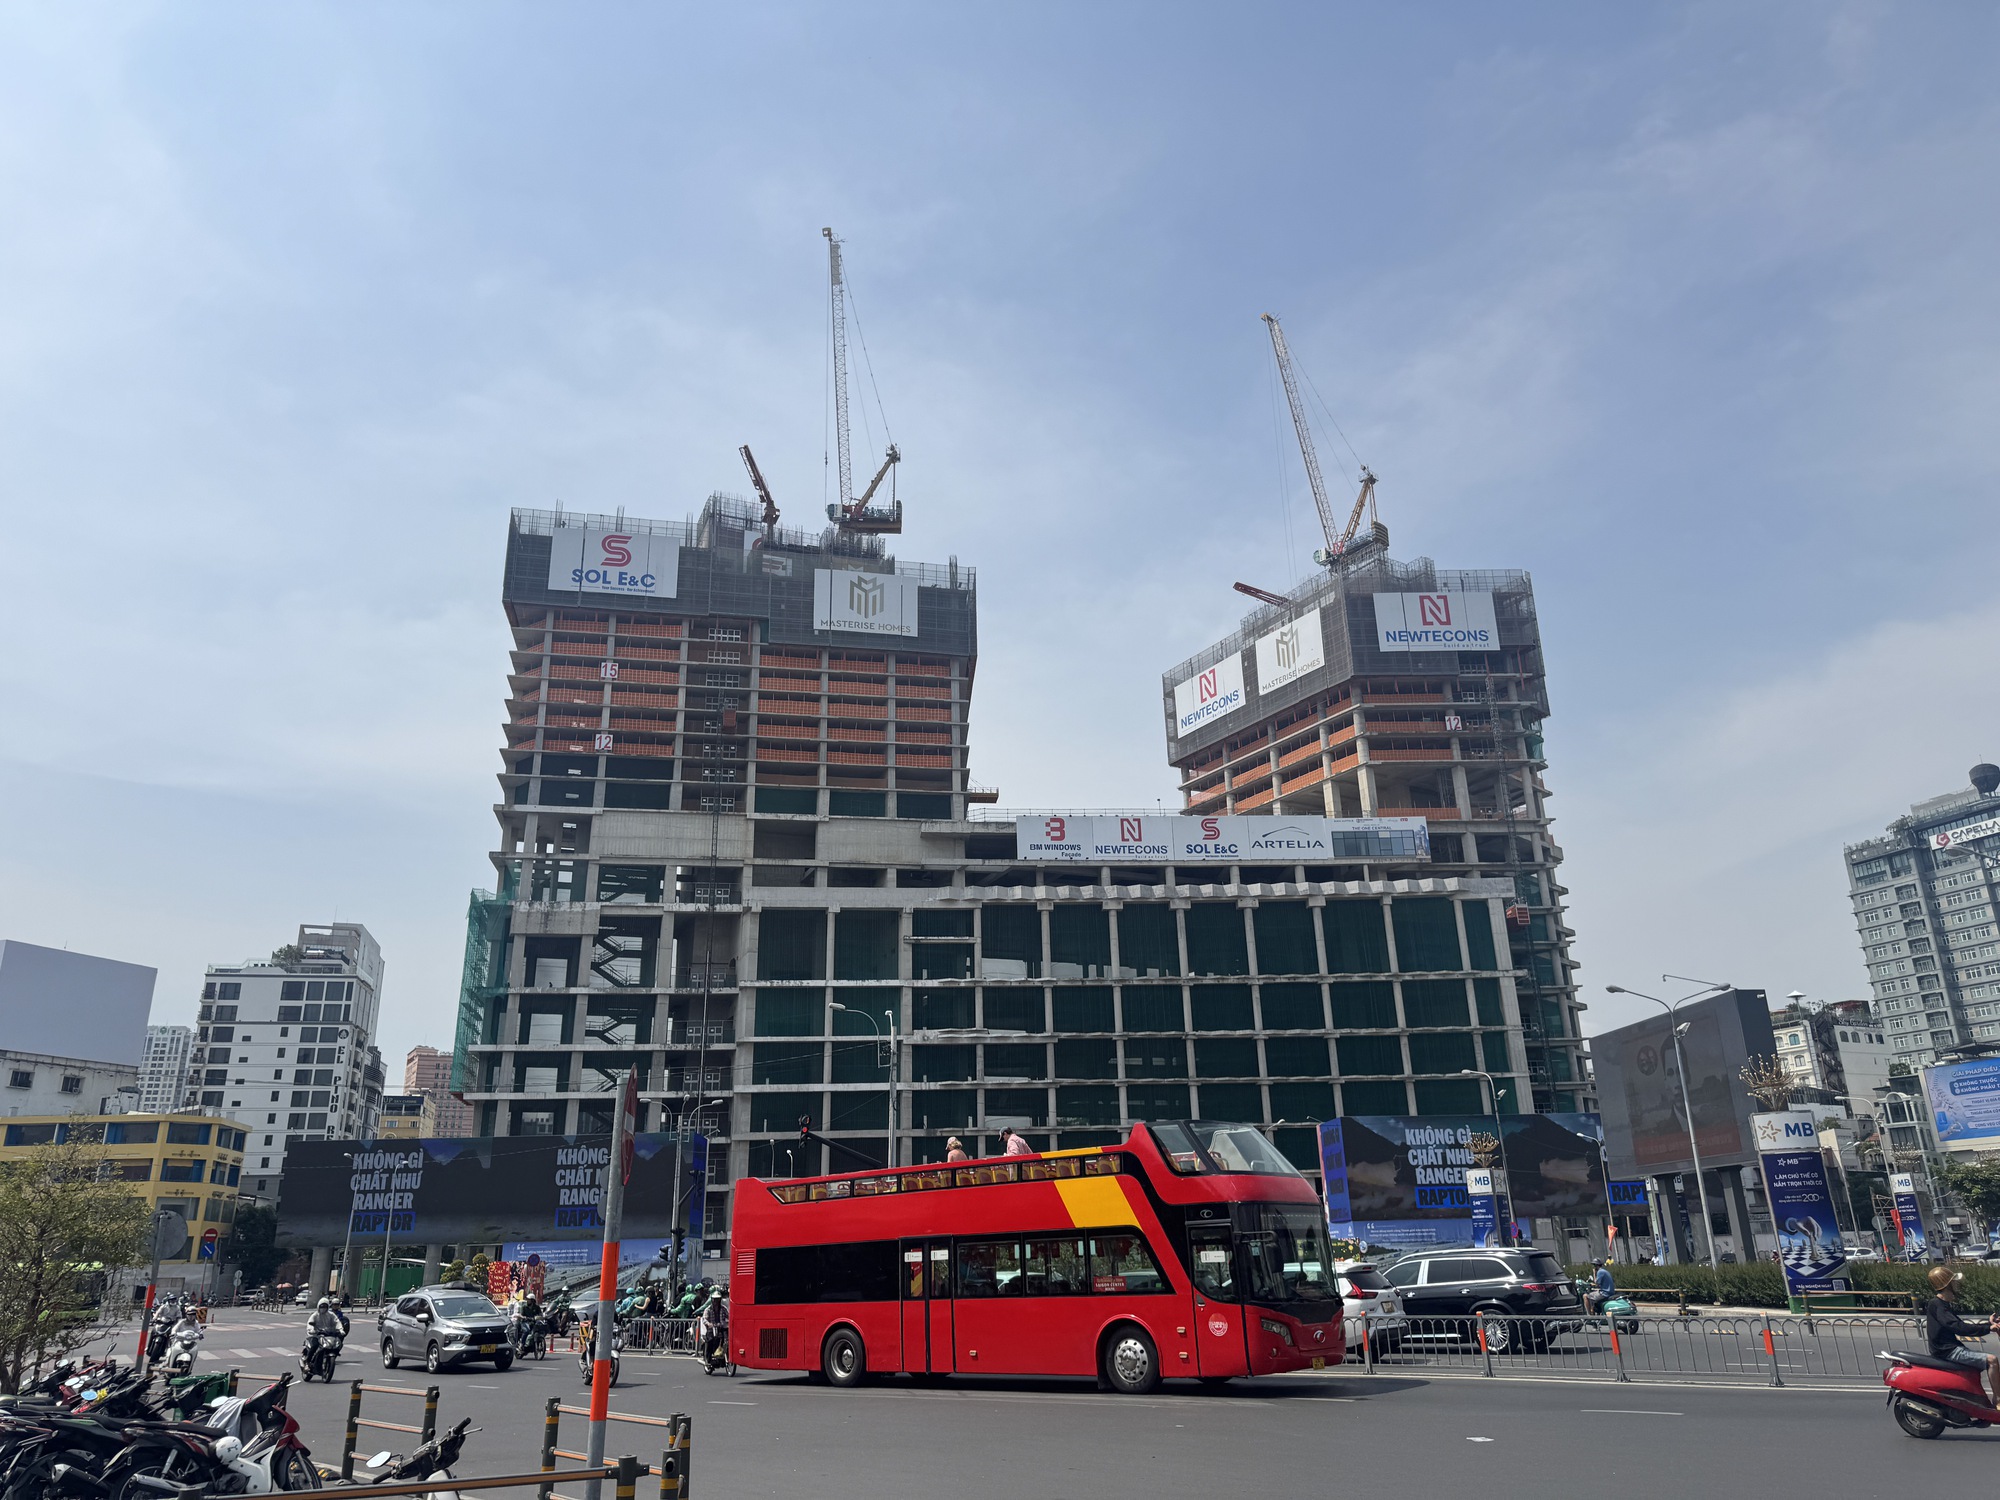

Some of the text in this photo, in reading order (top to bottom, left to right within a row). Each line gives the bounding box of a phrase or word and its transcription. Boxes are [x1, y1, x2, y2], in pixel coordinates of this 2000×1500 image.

[572, 569, 656, 587] SOL E&C
[820, 619, 911, 633] MASTERISE HOMES
[1386, 630, 1489, 642] NEWTECONS
[602, 663, 617, 677] 15
[1262, 658, 1320, 691] MASTERISE HOMES
[1180, 690, 1239, 728] NEWTECONS
[1447, 717, 1461, 729] 12
[597, 736, 612, 749] 12
[1951, 821, 2000, 839] CAPELLA
[1096, 845, 1168, 854] NEWTECONS
[1186, 844, 1238, 854] SOL E&C
[1252, 840, 1324, 848] ARTELIA
[326, 1046, 345, 1140] EL PINO RE
[1405, 1125, 1472, 1145] KHÔNG GÌ
[1785, 1122, 1814, 1137] MB
[353, 1148, 424, 1170] KHÔNG GÌ
[557, 1145, 608, 1165] KHÔNG
[1408, 1144, 1443, 1165] CHẤT
[350, 1169, 423, 1190] CHẤT NHƯ
[555, 1164, 593, 1186] CHẤT
[1475, 1176, 1490, 1186] MB
[354, 1192, 414, 1210] RANGER
[559, 1188, 605, 1205] RANG
[1611, 1185, 1647, 1201] RAPT
[351, 1214, 413, 1232] RAPTOR
[558, 1210, 605, 1227] RAPT
